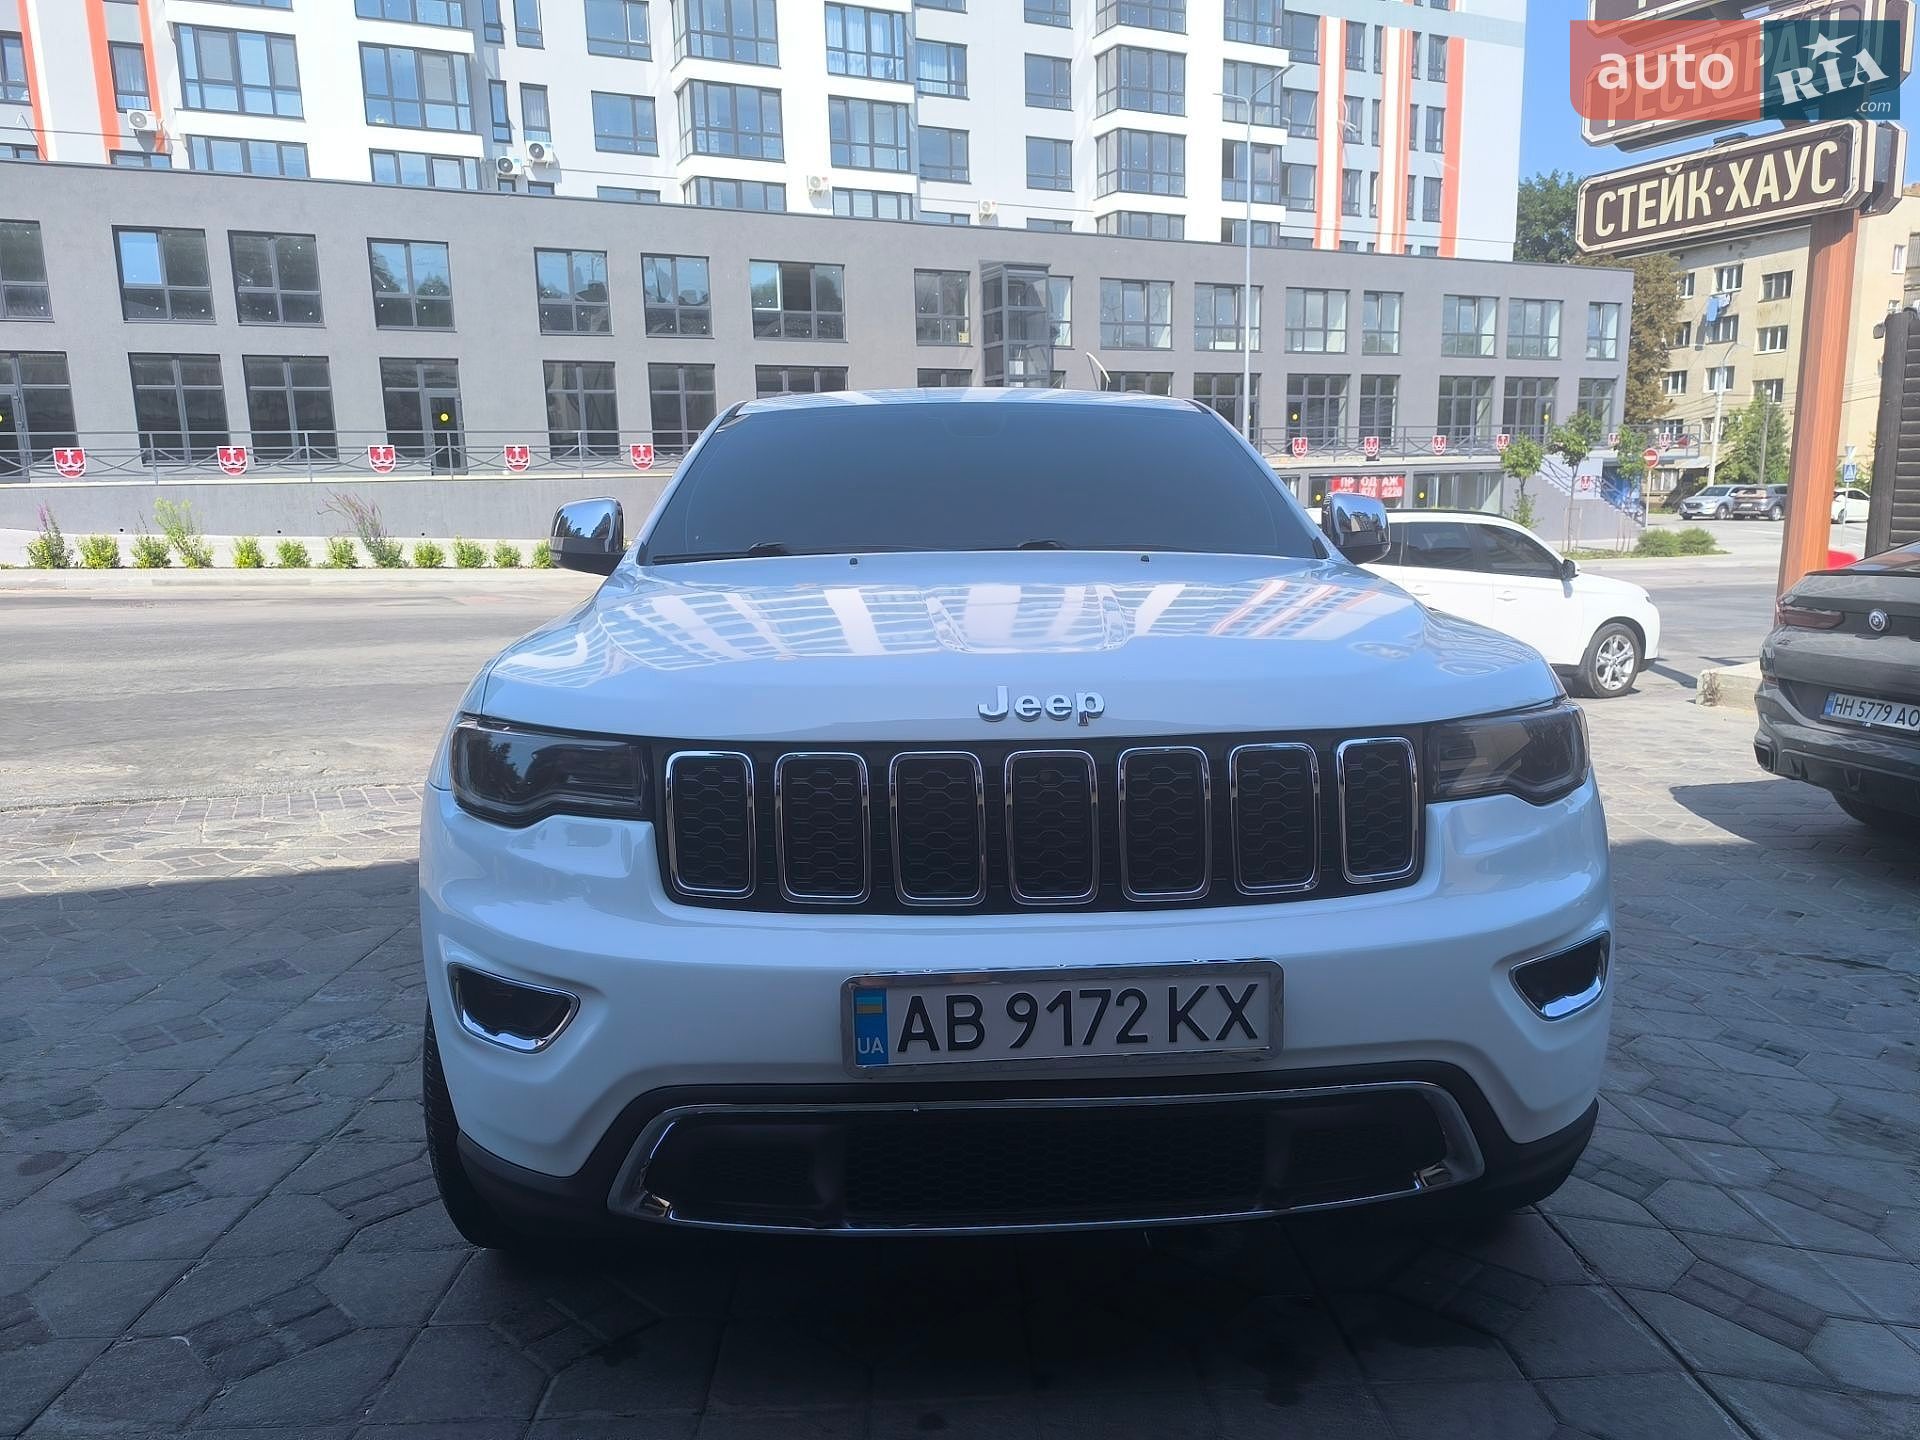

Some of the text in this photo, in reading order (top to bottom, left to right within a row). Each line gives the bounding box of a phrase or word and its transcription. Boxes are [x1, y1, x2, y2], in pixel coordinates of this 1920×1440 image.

[977, 685, 1105, 727] Jeep
[1832, 695, 1855, 717] HH
[1856, 700, 1893, 723] 5779
[897, 983, 1259, 1053] AB 9172 KX
[857, 1036, 885, 1055] UA
